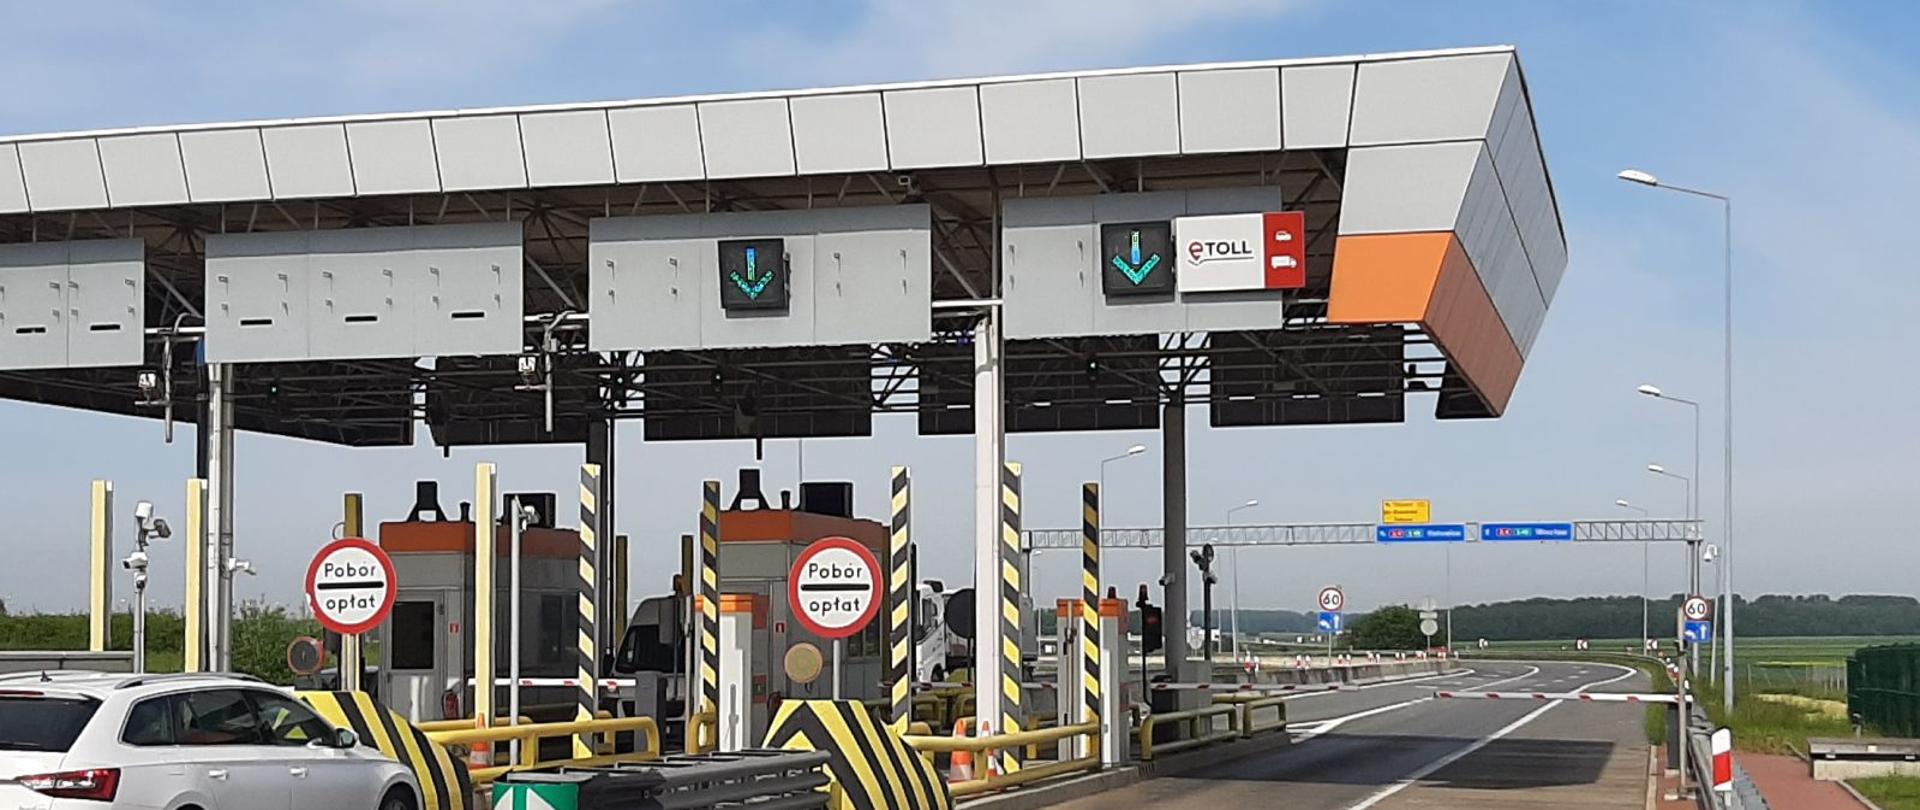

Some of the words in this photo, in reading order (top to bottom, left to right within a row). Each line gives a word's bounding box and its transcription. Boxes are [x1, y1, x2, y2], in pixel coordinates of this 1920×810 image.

[1188, 240, 1252, 261] eTOLL
[324, 562, 376, 578] Pobór
[808, 562, 862, 579] Pobór
[326, 594, 376, 614] opłat
[809, 596, 860, 616] opłat
[1322, 594, 1340, 605] 60
[1687, 603, 1706, 615] 60
